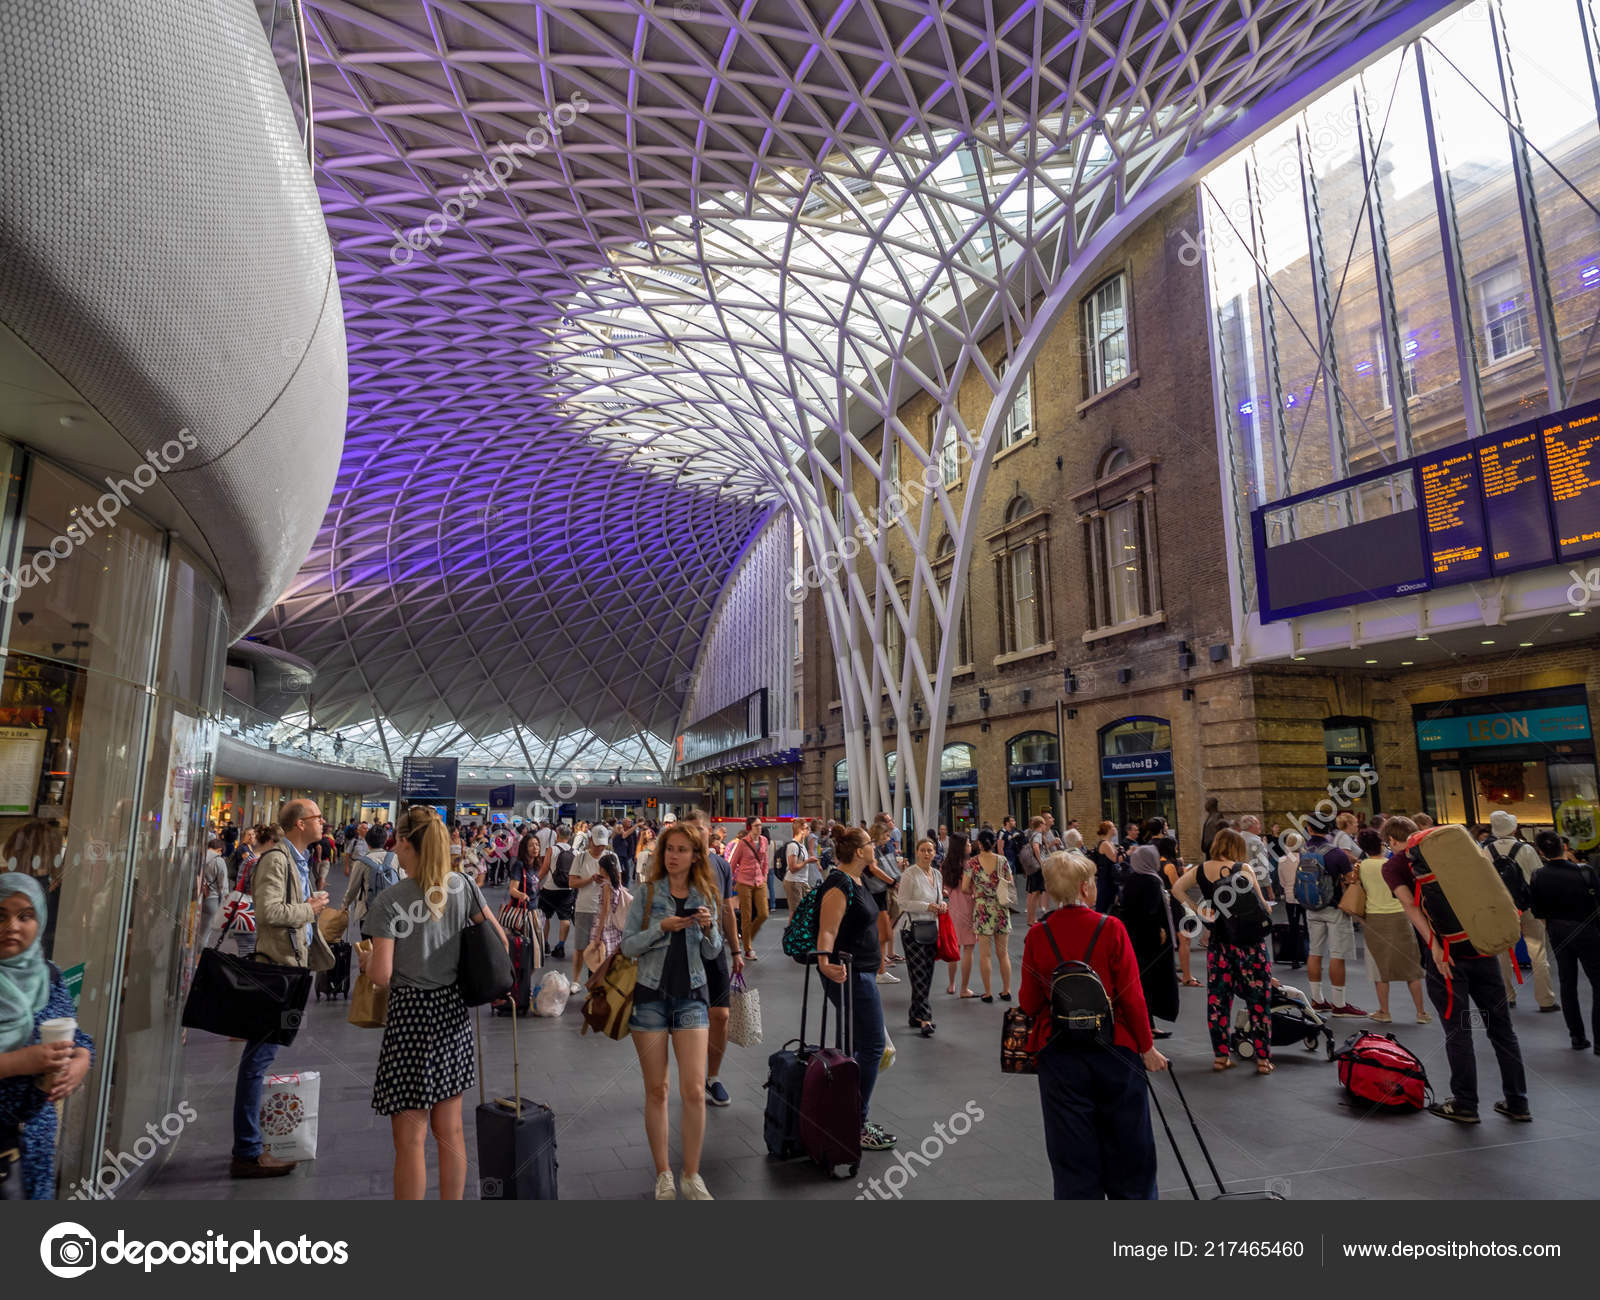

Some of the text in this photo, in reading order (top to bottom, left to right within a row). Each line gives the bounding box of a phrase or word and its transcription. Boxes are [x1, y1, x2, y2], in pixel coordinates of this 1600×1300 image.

[1568, 415, 1598, 429] Platform
[1503, 436, 1529, 449] Platform
[1442, 456, 1467, 467] Platform
[1481, 453, 1499, 463] Leeds
[1560, 535, 1580, 546] Great
[1396, 582, 1428, 593] JCDecaux
[1468, 717, 1529, 742] LEON
[1112, 761, 1132, 770] Platforms
